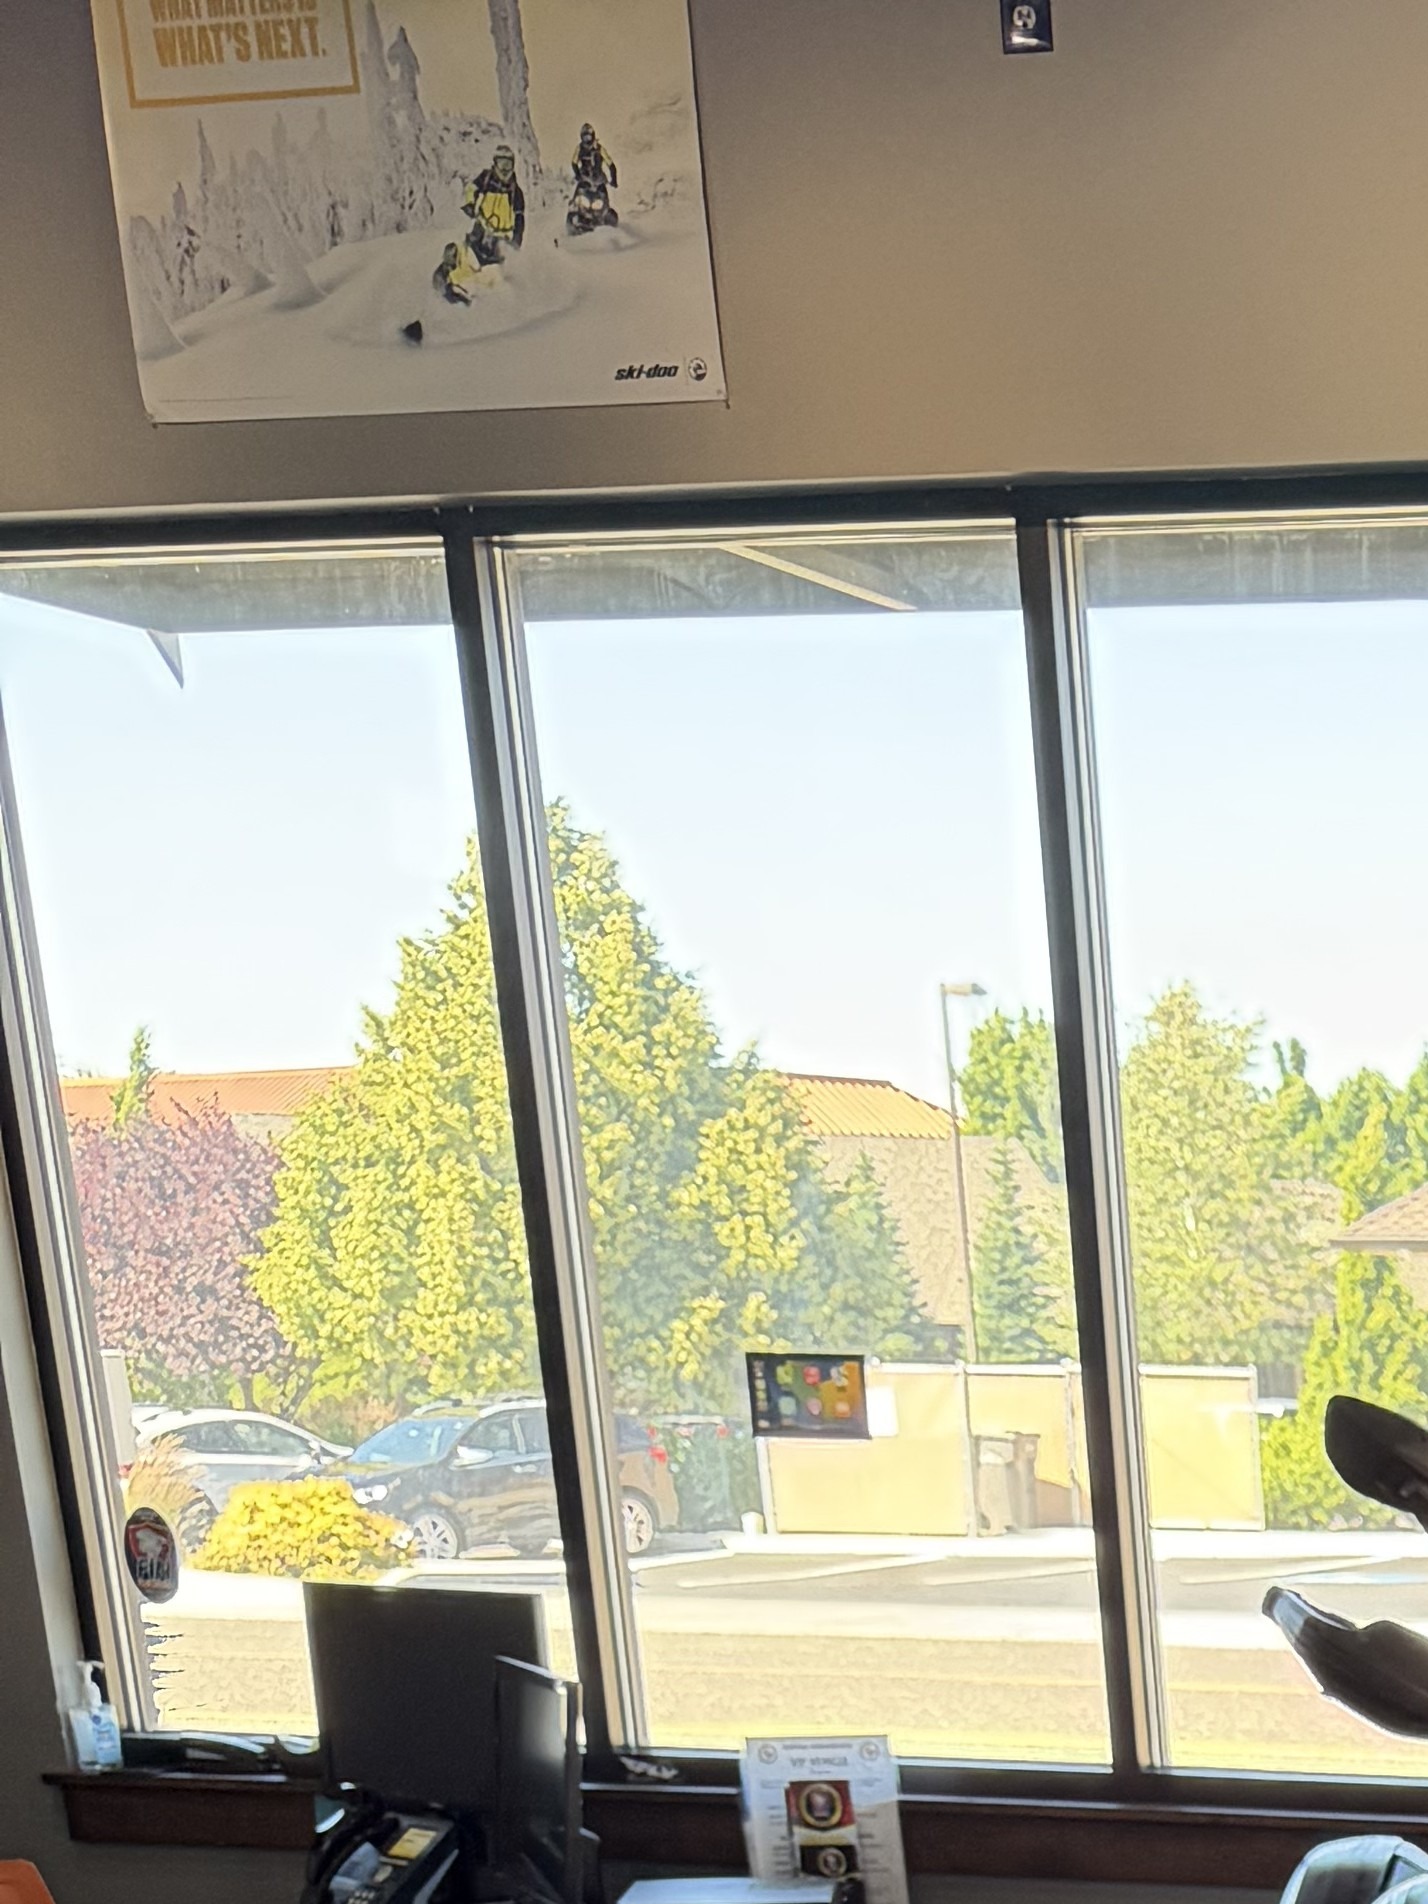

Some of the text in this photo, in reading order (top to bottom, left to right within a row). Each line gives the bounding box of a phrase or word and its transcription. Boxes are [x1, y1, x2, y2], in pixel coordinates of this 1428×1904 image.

[152, 17, 328, 68] WHAT'S NEXT.
[615, 364, 679, 380] ski-doo
